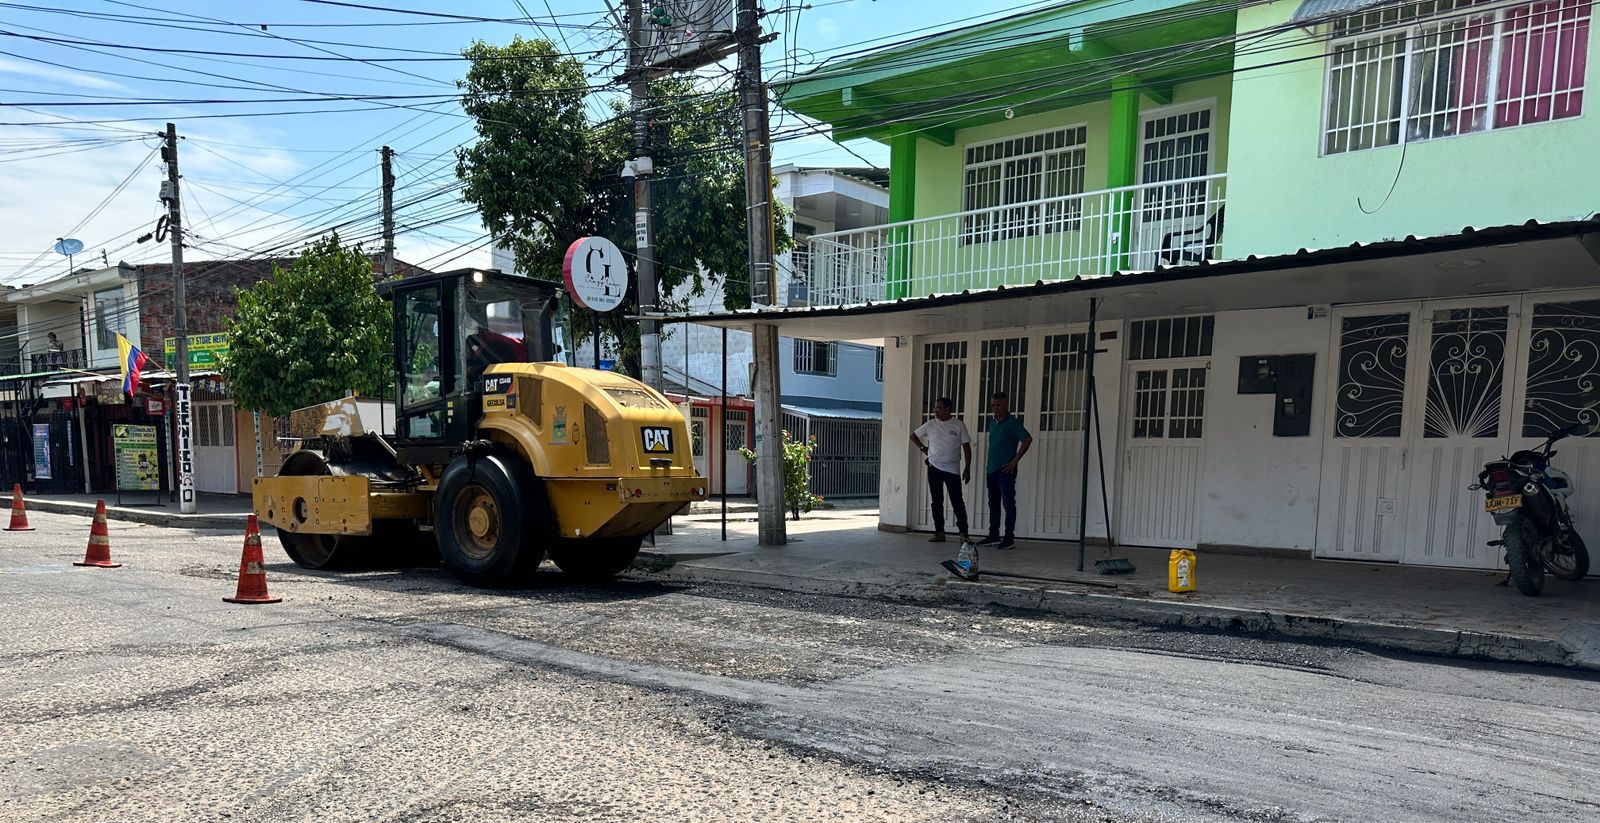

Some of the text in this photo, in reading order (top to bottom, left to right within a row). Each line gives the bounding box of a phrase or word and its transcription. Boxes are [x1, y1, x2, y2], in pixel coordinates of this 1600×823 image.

[196, 335, 211, 344] STORE
[485, 379, 498, 392] CAT
[487, 399, 505, 407] GECOLSA
[644, 428, 669, 451] CAT
